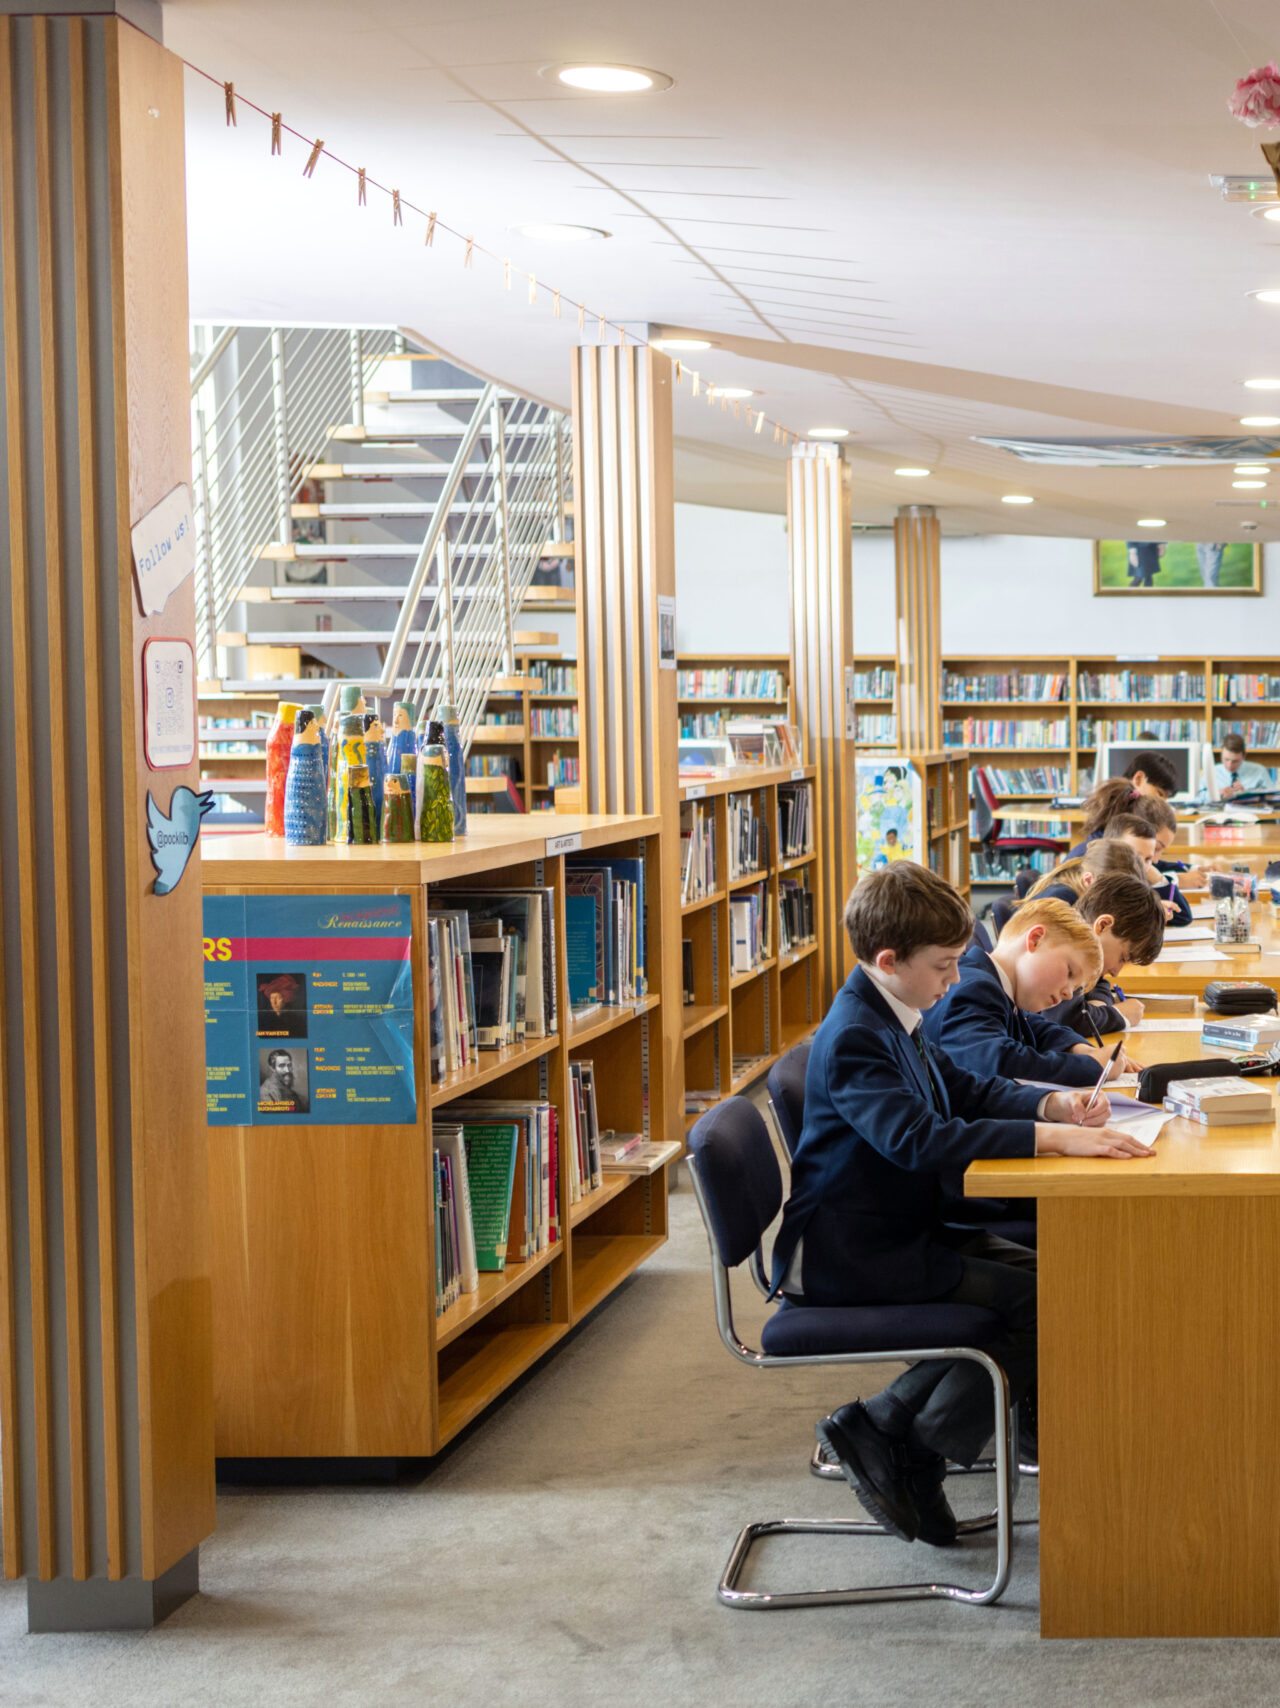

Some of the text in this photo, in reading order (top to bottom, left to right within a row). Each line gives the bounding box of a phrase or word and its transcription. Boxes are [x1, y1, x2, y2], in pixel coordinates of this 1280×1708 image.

[139, 514, 189, 577] Follow us!
[157, 830, 189, 848] @pocklib
[318, 914, 402, 929] Renaissance
